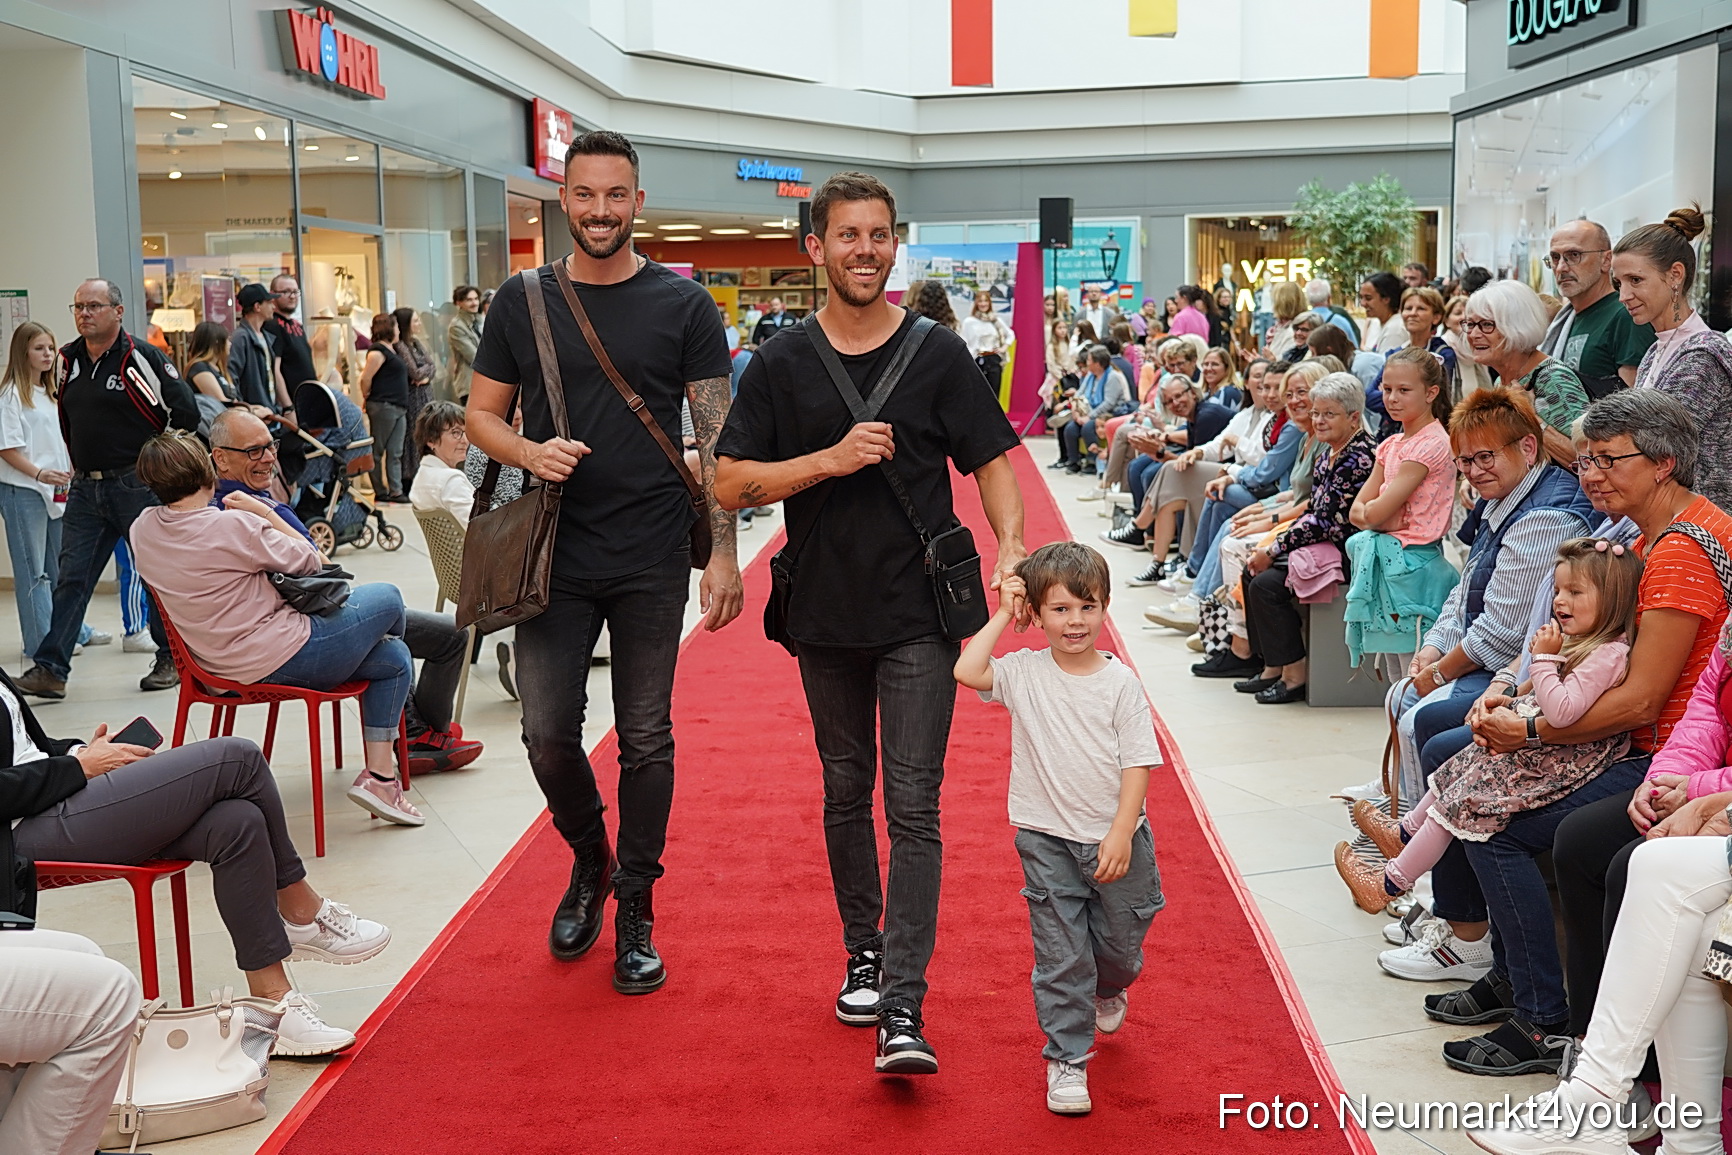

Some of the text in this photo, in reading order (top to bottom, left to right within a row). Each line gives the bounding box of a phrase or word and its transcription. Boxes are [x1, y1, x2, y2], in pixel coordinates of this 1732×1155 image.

[1507, 0, 1601, 45] DOUGL
[287, 6, 386, 100] WÖHRL
[736, 158, 803, 181] Spielwaren
[226, 218, 241, 226] THE
[243, 217, 273, 225] MAKER
[1240, 257, 1325, 284] VER
[105, 374, 127, 391] 63
